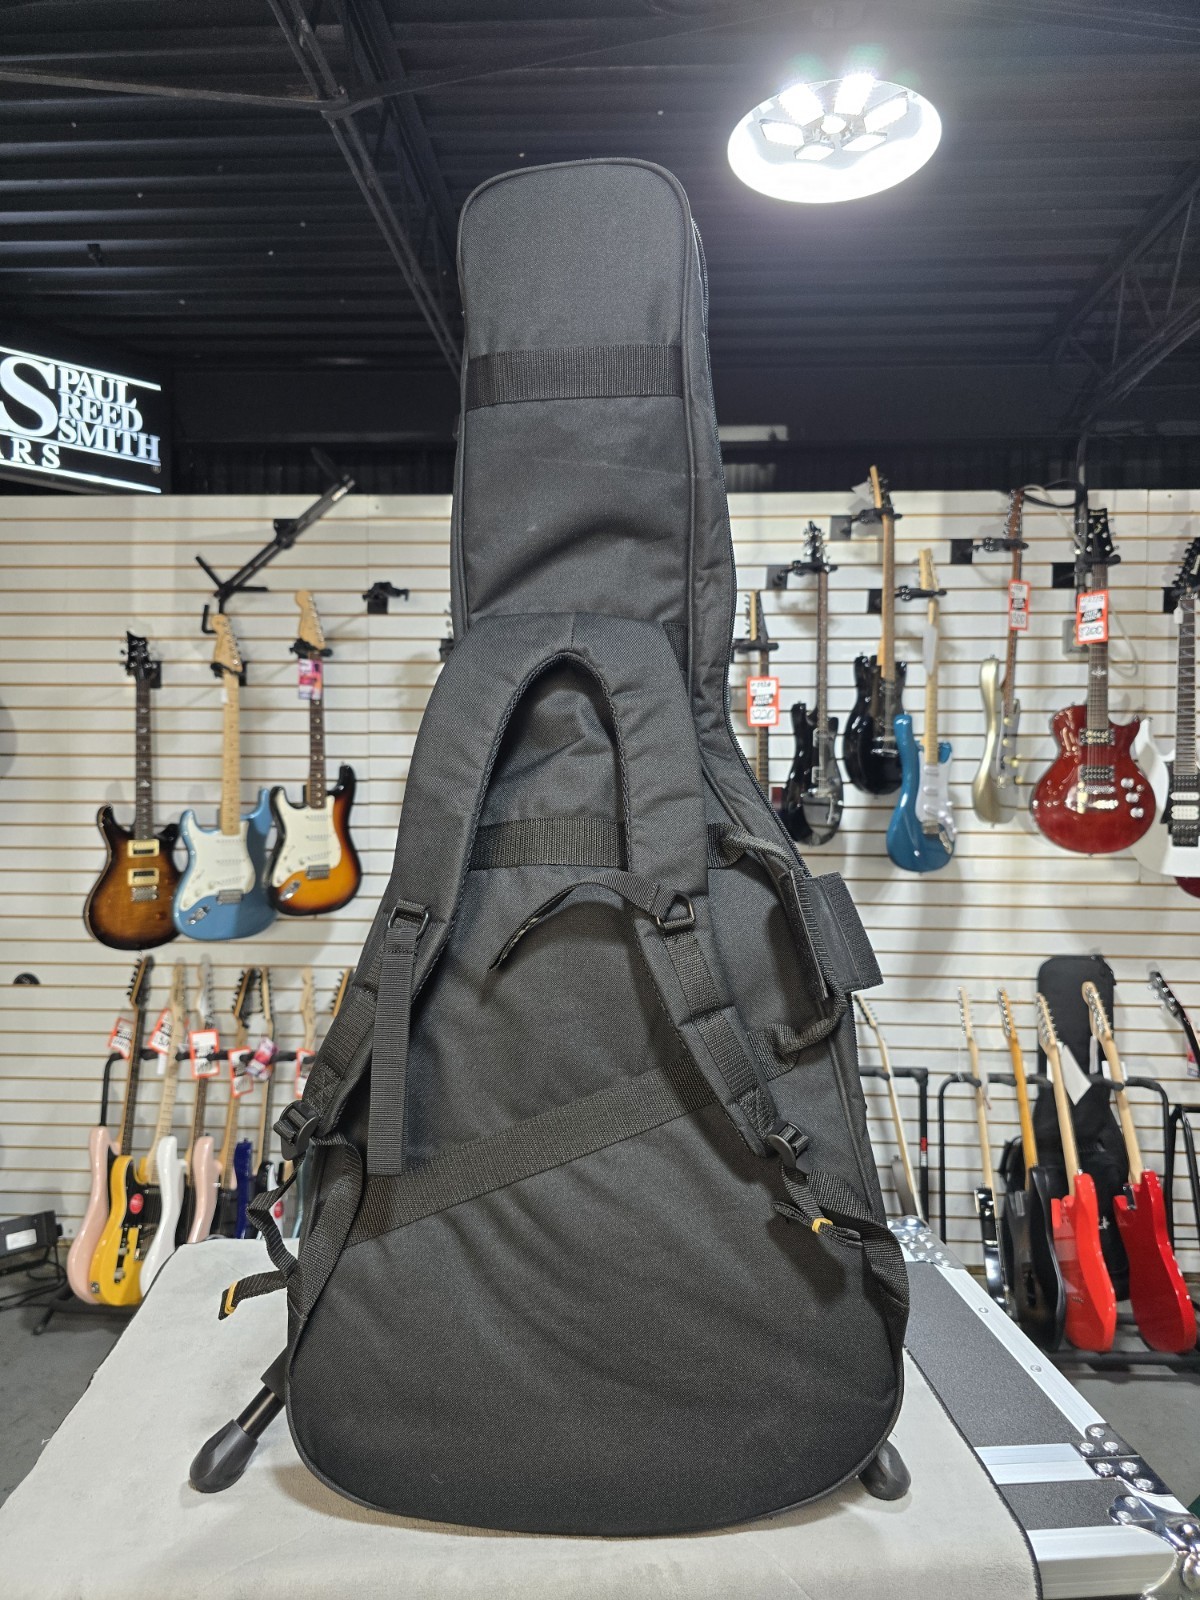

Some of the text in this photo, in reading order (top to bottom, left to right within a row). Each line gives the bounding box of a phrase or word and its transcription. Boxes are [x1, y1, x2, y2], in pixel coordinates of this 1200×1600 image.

[57, 366, 138, 409] PAUL
[58, 392, 144, 432] REED
[57, 417, 161, 462] SMITH
